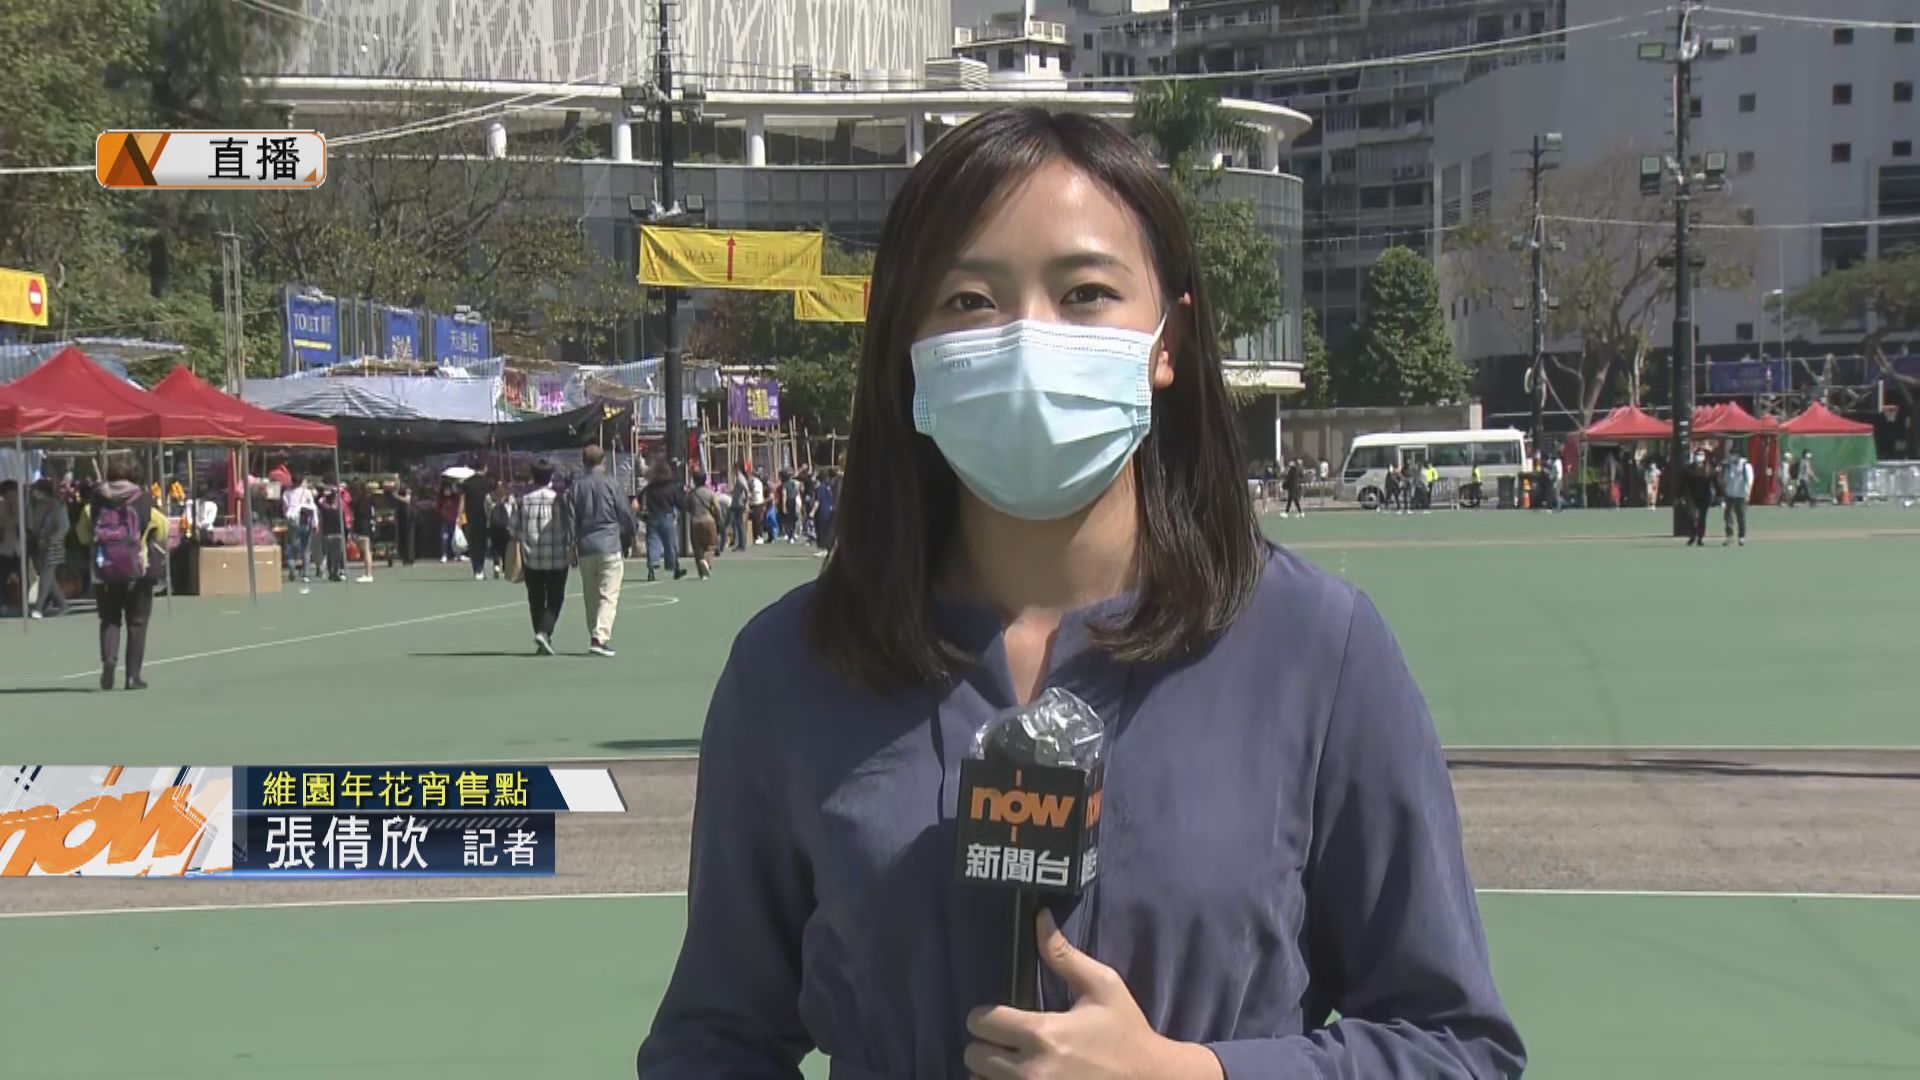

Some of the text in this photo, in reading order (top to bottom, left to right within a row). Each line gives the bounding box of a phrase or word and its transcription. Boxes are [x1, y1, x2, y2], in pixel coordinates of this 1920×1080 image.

[970, 786, 1075, 829] now
[965, 843, 1070, 887] 新聞台
